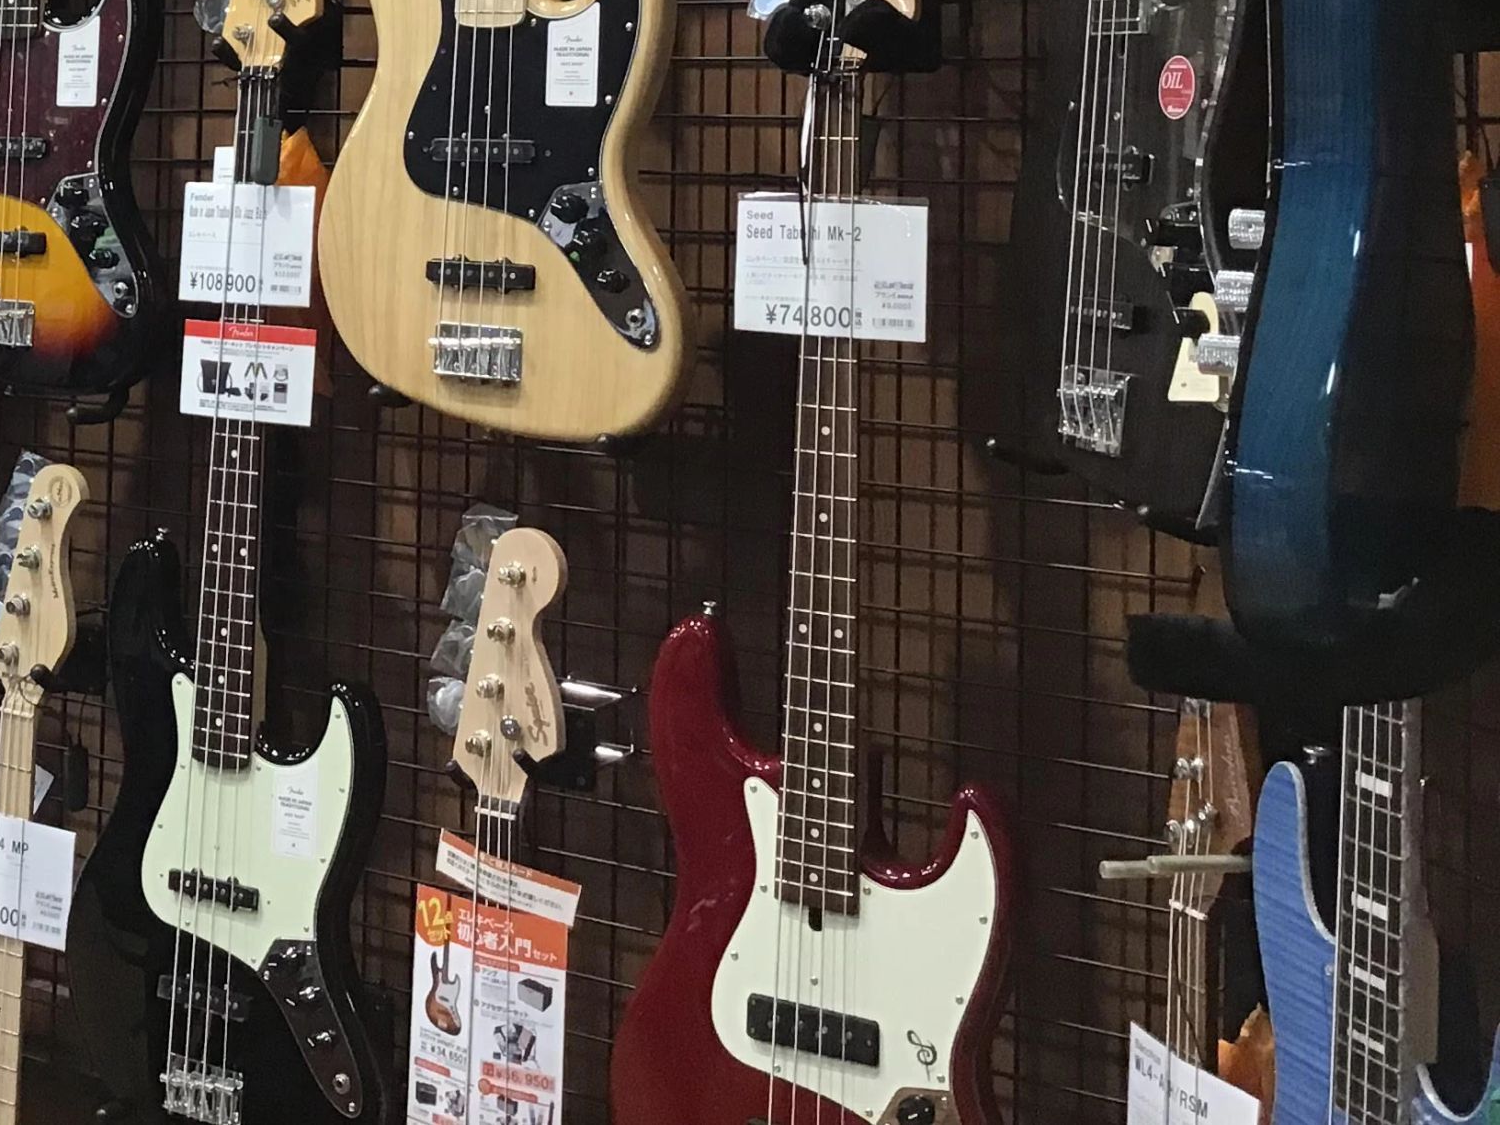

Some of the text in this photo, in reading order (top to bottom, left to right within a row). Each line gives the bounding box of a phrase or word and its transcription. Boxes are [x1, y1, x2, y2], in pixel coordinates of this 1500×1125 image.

[1162, 72, 1183, 89] OIL
[747, 210, 773, 220] Seed
[747, 225, 773, 240] Seed
[780, 225, 821, 241] Tabhi
[190, 271, 256, 293] ¥108900
[766, 303, 851, 329] ¥74800
[458, 909, 514, 933] エレキベース
